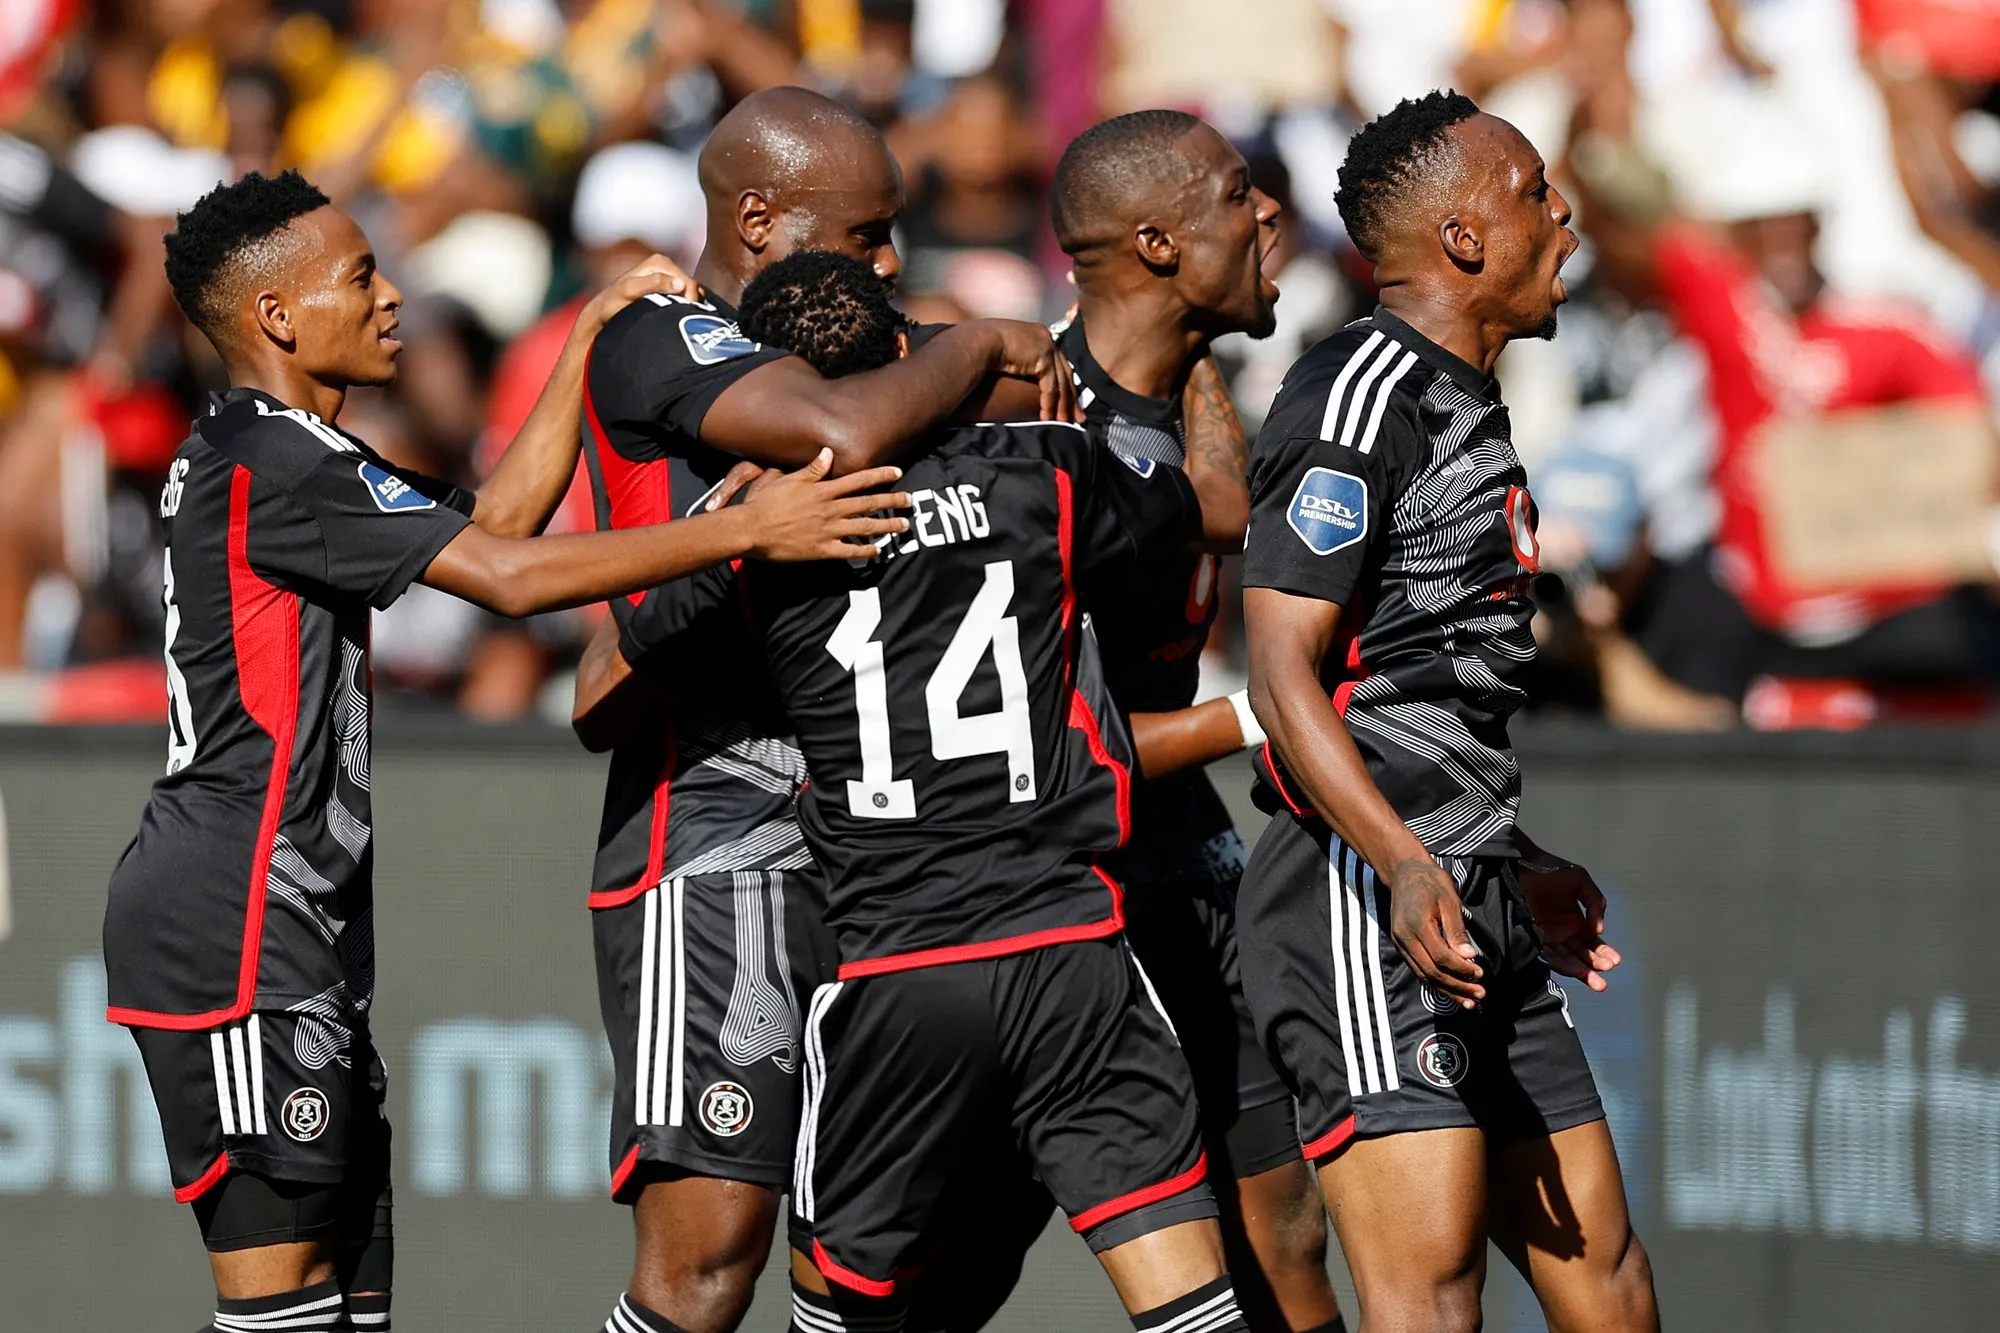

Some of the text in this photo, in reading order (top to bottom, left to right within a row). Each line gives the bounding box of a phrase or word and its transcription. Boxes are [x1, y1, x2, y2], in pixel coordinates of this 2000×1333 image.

[868, 484, 990, 561] ENG
[1299, 508, 1357, 531] PREMIERSHIP
[825, 560, 1036, 819] 14
[410, 1016, 616, 1196] m
